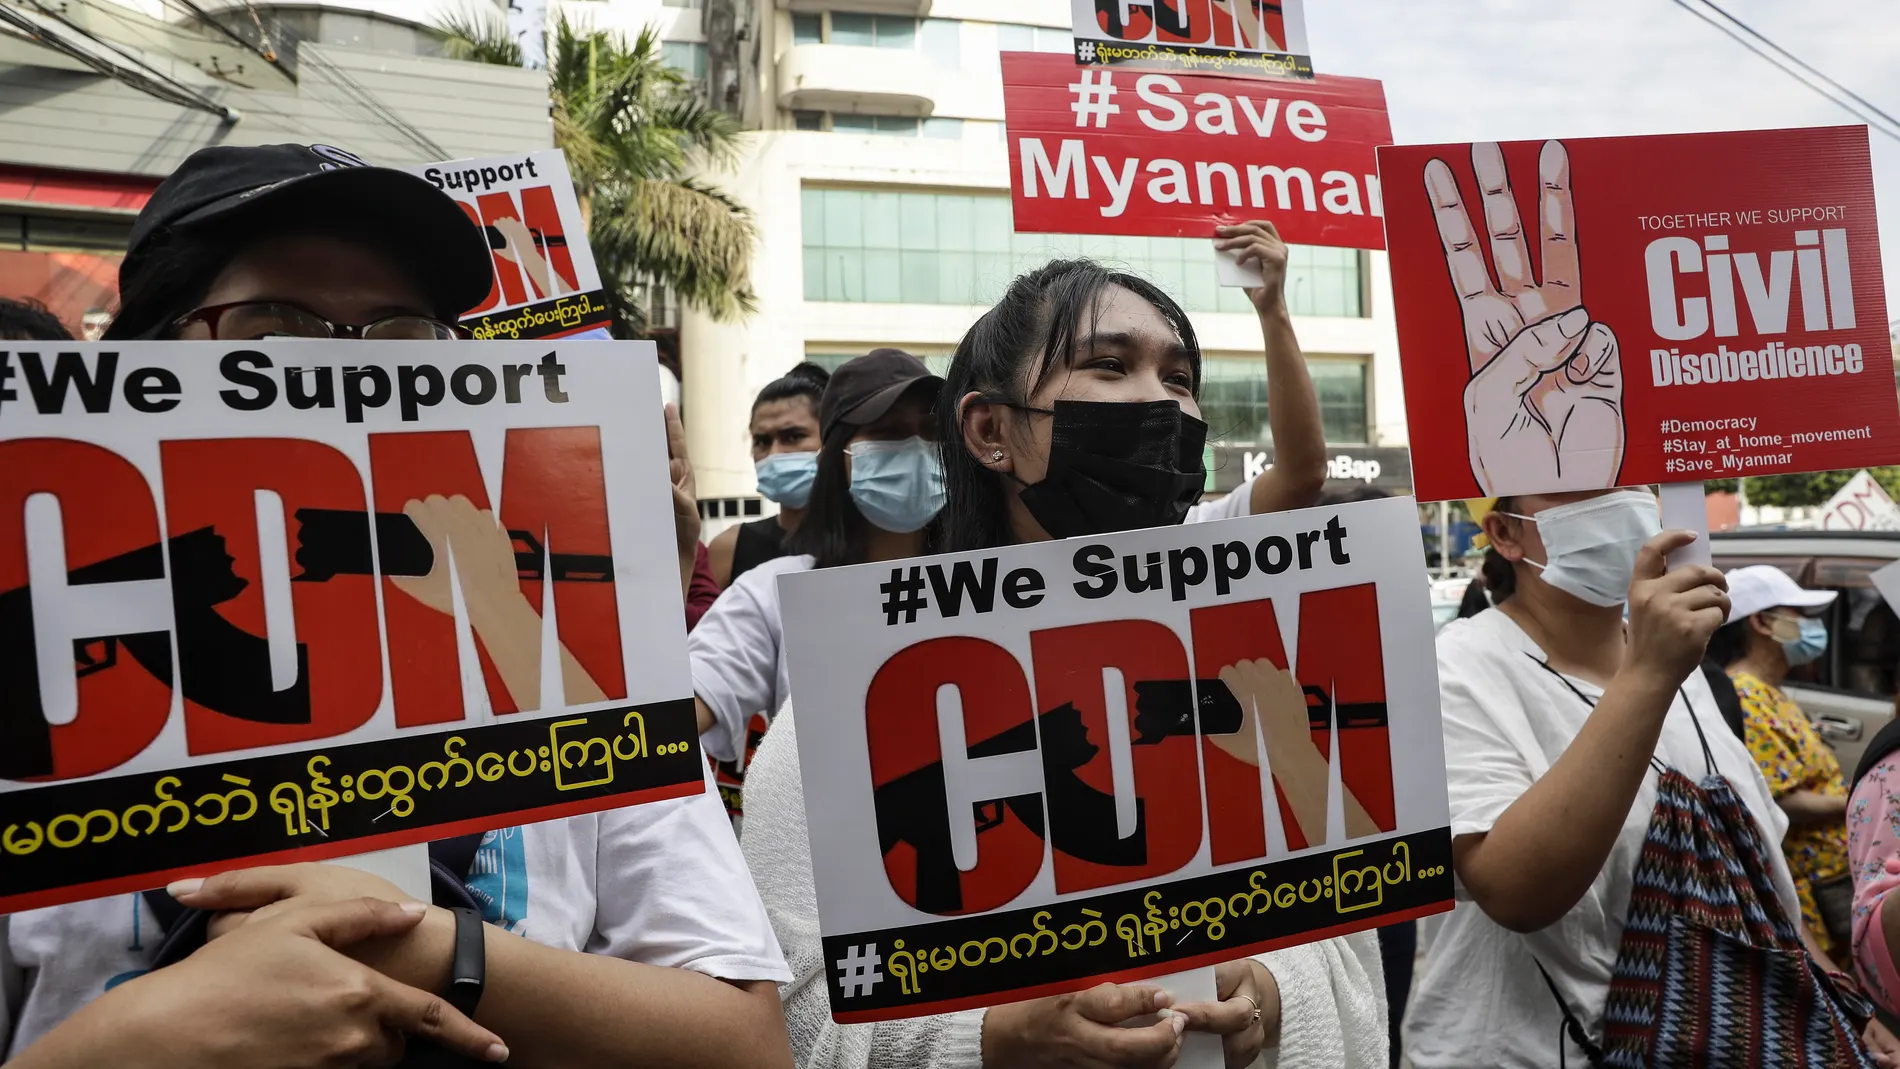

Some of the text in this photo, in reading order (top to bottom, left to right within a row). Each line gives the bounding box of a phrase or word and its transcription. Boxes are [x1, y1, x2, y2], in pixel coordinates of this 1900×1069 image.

[424, 156, 538, 192] Support
[1638, 205, 1847, 231] TOGETHER WE SUPPORT
[1644, 228, 1857, 341] Civil
[218, 349, 570, 423] Support
[1650, 341, 1864, 388] Disobedience
[1660, 416, 1758, 434] #Democracy
[1663, 425, 1872, 454] #Stay_at_home_movement
[1665, 452, 1793, 473] #Save_Myanmar
[880, 514, 1351, 626] #We Support
[0, 424, 628, 783] CDM
[865, 581, 1397, 917] CDM
